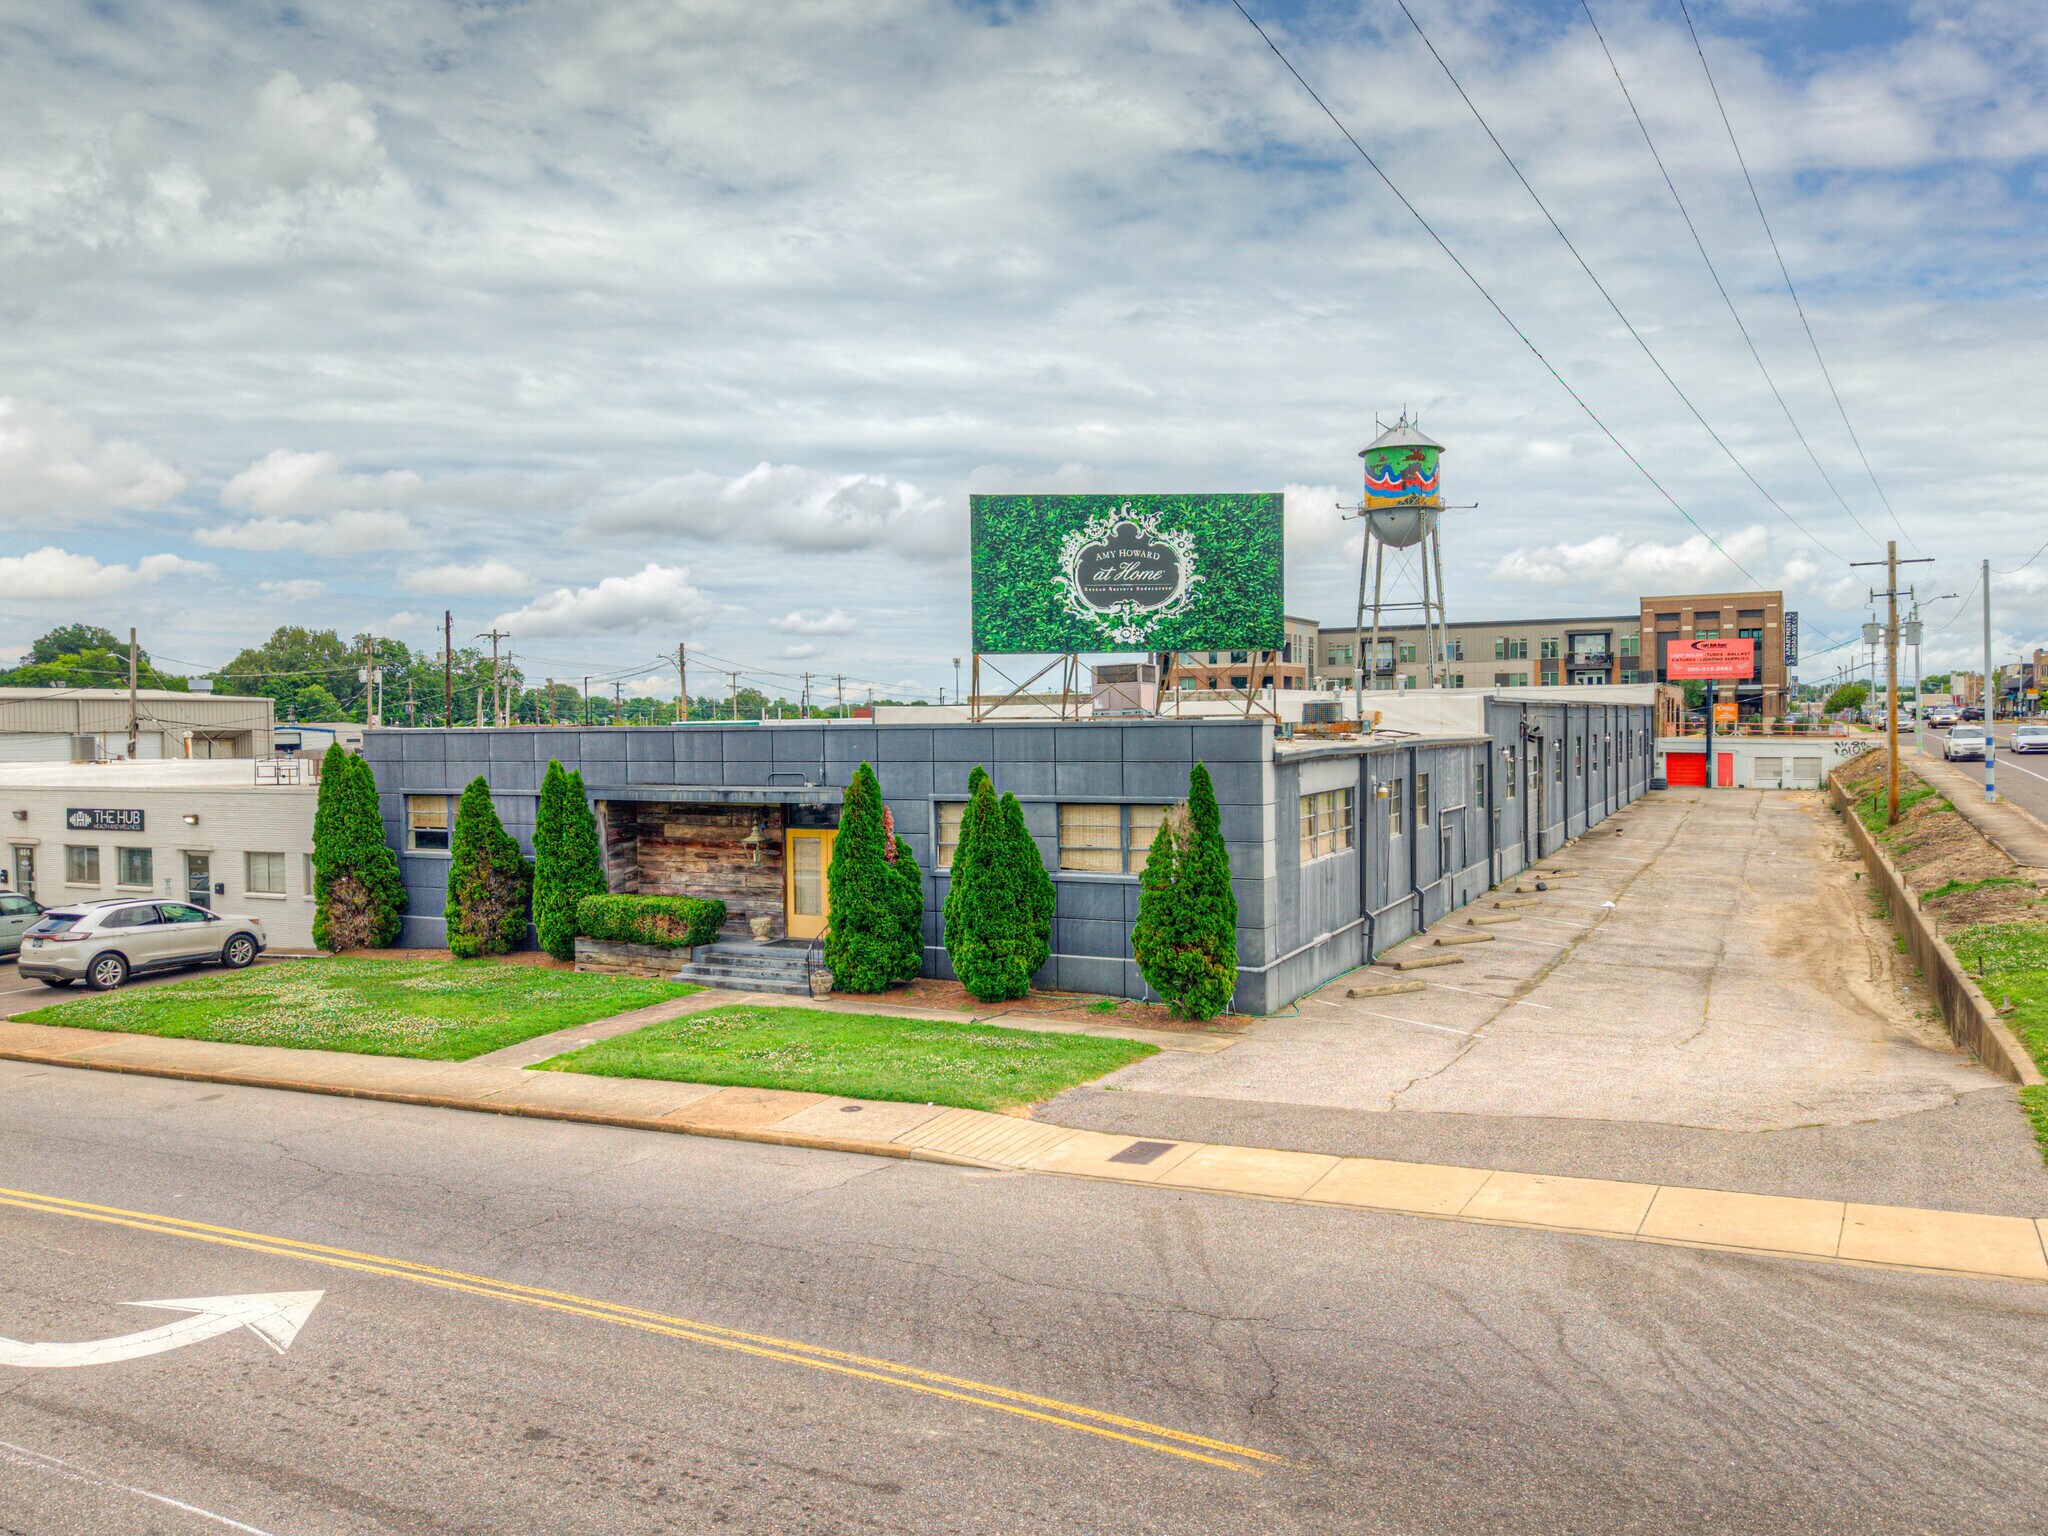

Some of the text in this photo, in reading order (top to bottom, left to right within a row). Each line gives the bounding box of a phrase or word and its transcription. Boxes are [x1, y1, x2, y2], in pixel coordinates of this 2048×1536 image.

[1096, 549, 1160, 561] AMY HOWARD
[1093, 561, 1164, 581] at Home
[93, 810, 141, 824] THE HUB
